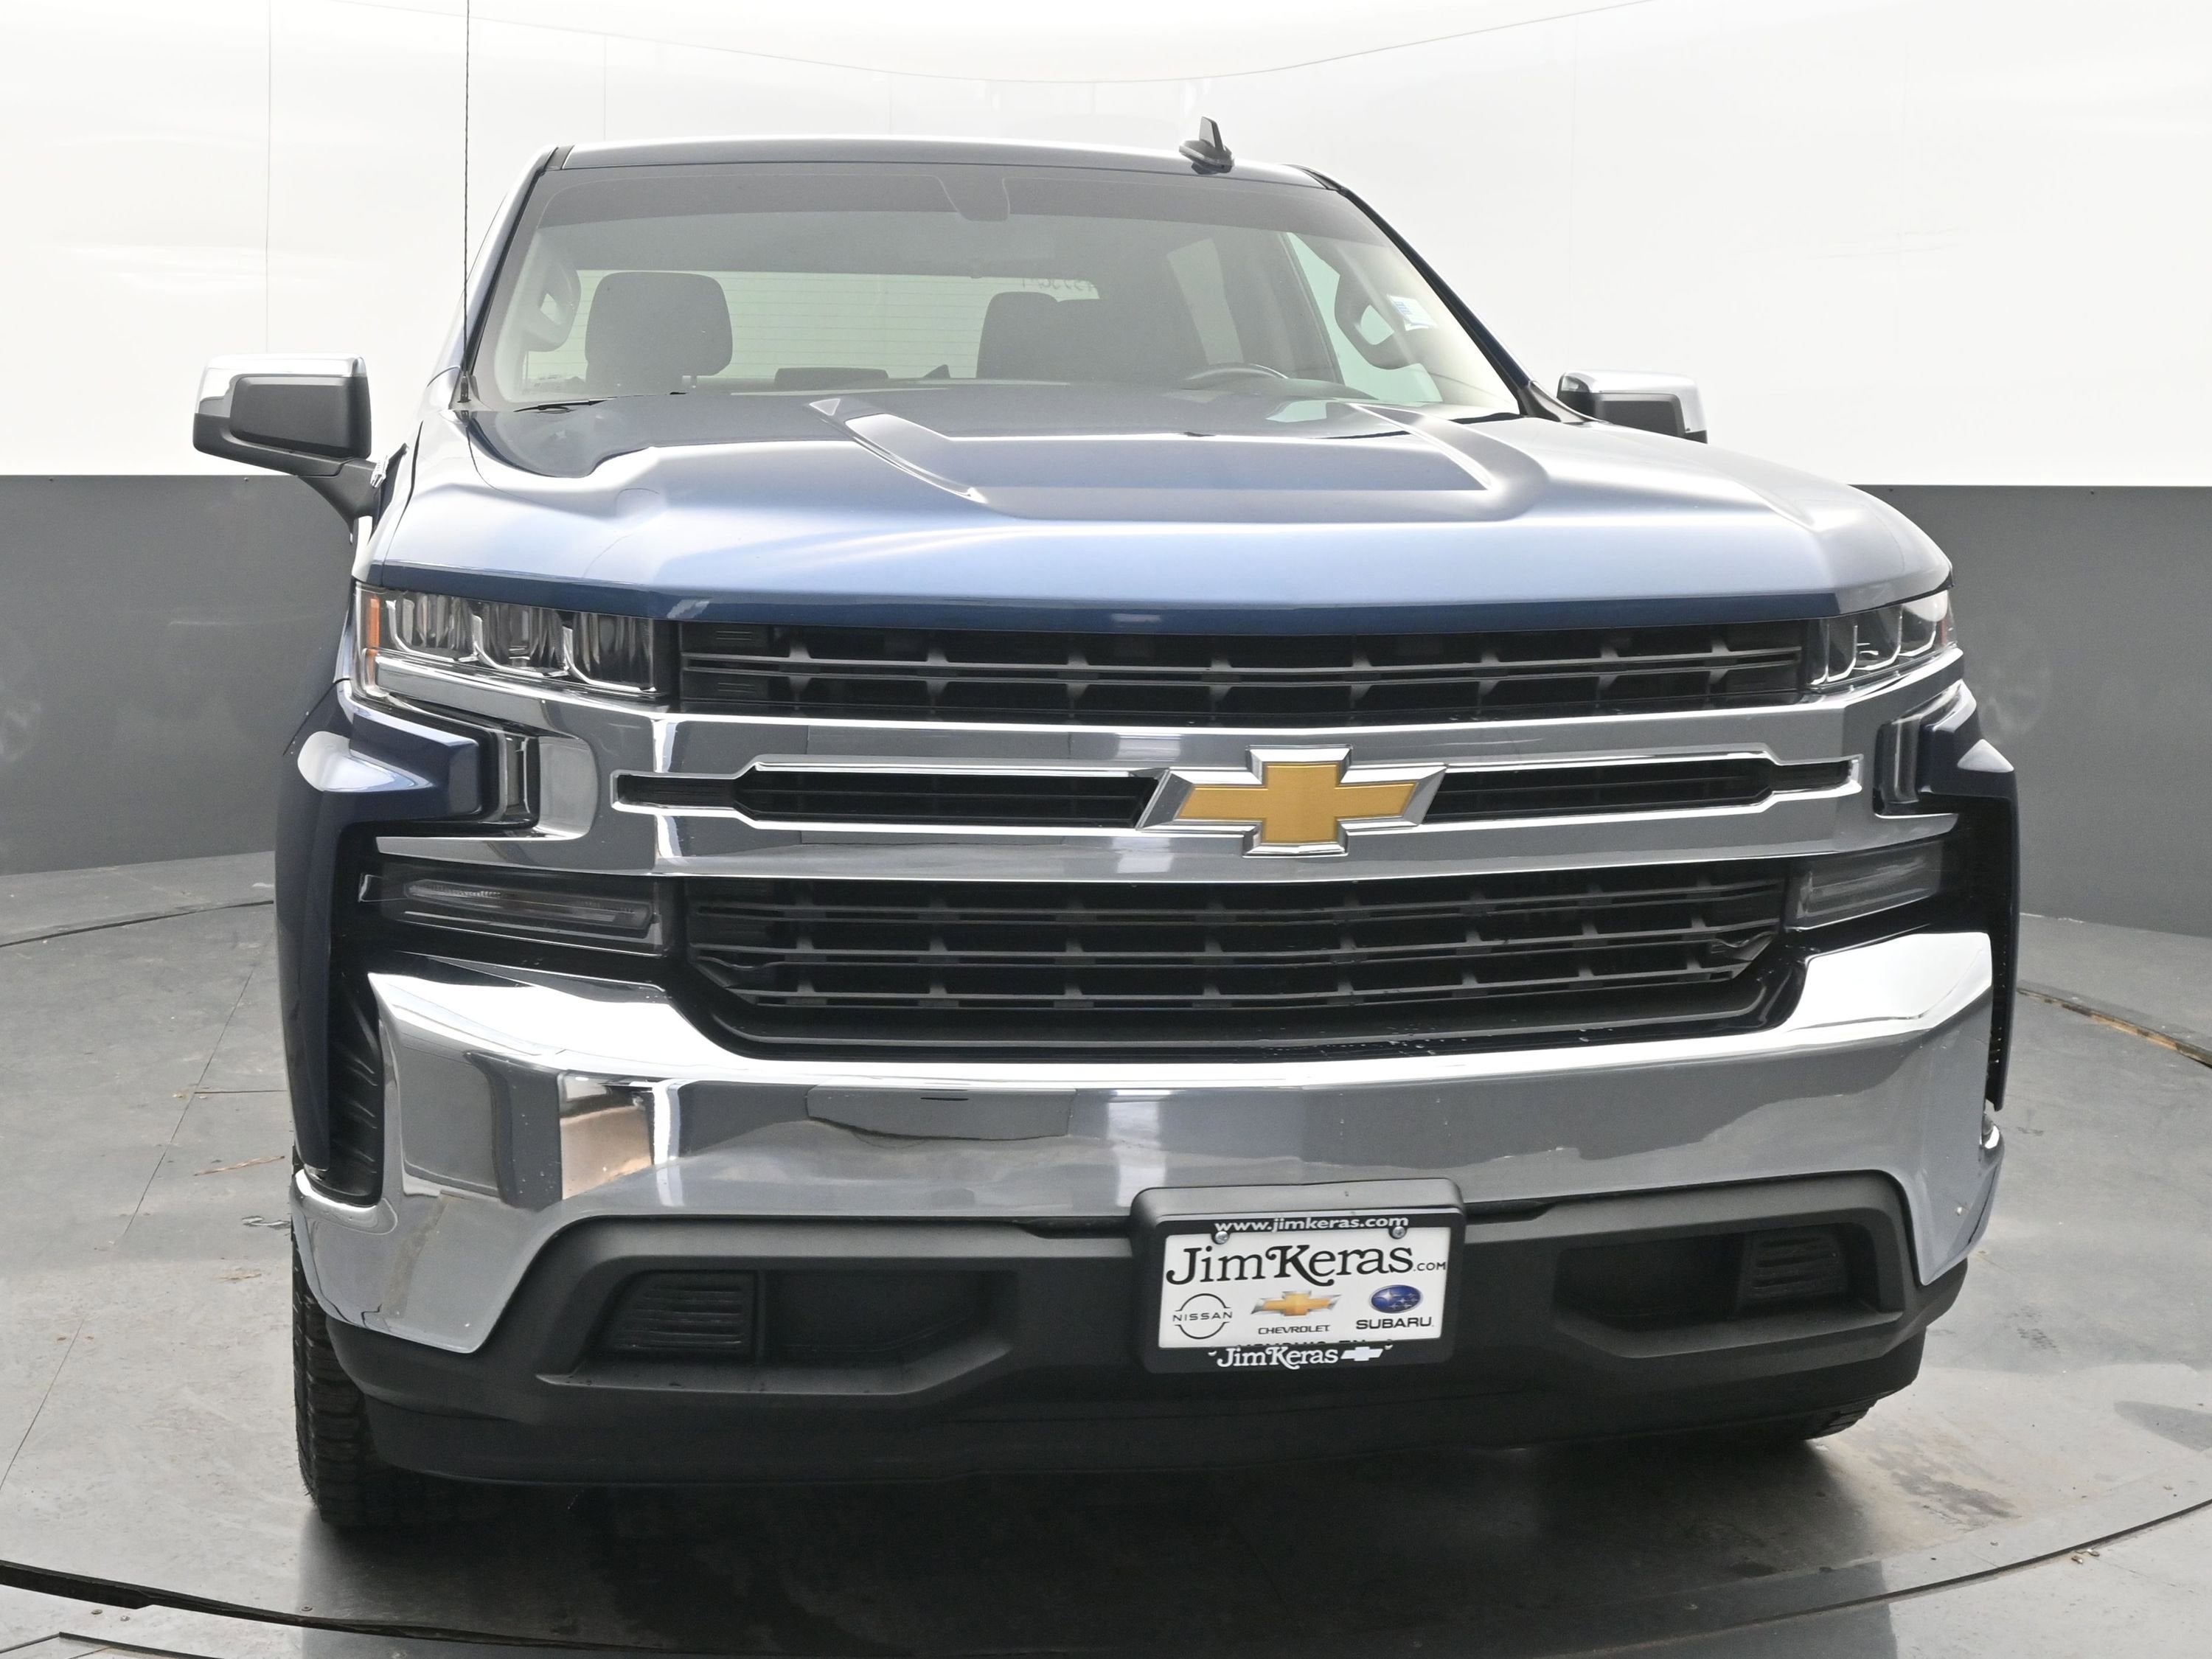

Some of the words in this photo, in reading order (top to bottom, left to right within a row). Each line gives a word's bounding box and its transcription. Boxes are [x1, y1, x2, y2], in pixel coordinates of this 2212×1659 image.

[1214, 1216, 1409, 1233] www.jimkeras.com
[1172, 1310, 1233, 1322] NISSAN
[1258, 1324, 1331, 1335] CHEVROLET
[1355, 1317, 1432, 1330] SUBARU
